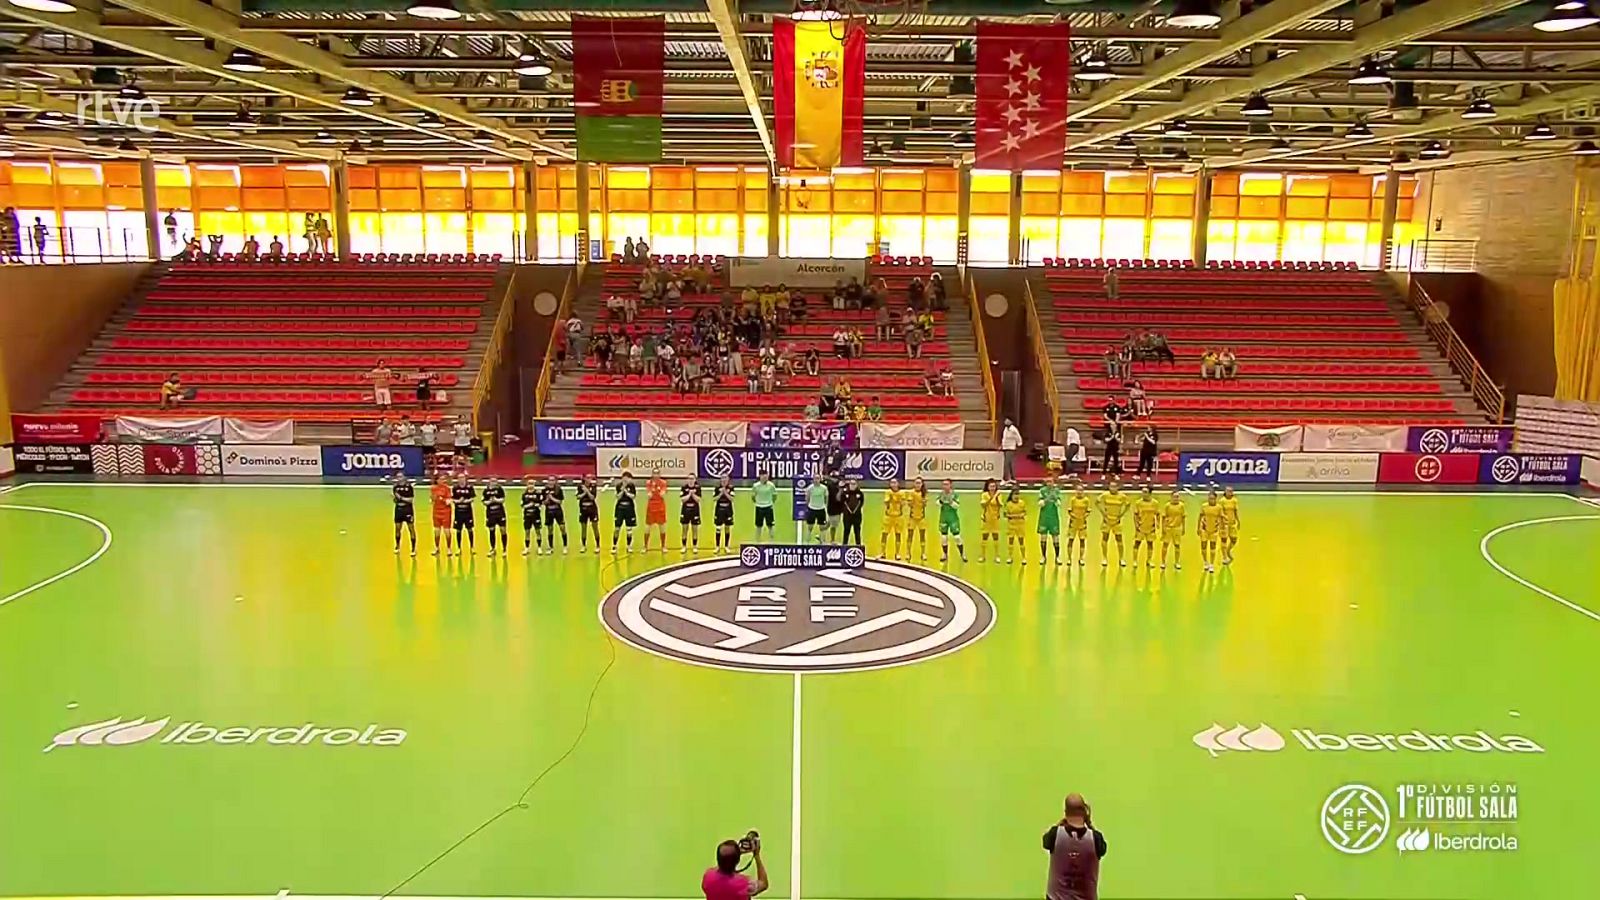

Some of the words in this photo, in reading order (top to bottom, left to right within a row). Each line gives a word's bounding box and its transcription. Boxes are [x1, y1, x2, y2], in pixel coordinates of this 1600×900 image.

[797, 263, 845, 273] Alcorcón
[548, 424, 627, 440] modelical
[677, 428, 738, 445] arriva
[897, 433, 960, 446] arriva.es
[240, 456, 287, 465] Domino's
[290, 457, 318, 465] Pizza
[756, 450, 820, 460] DIVISIÓ
[632, 457, 686, 468] Iberdrola
[941, 459, 994, 471] Iberdrola
[774, 552, 801, 566] FÚTBOL
[803, 554, 823, 566] SALA
[159, 721, 408, 746] Iberdrola
[1291, 729, 1546, 752] Iberdrola
